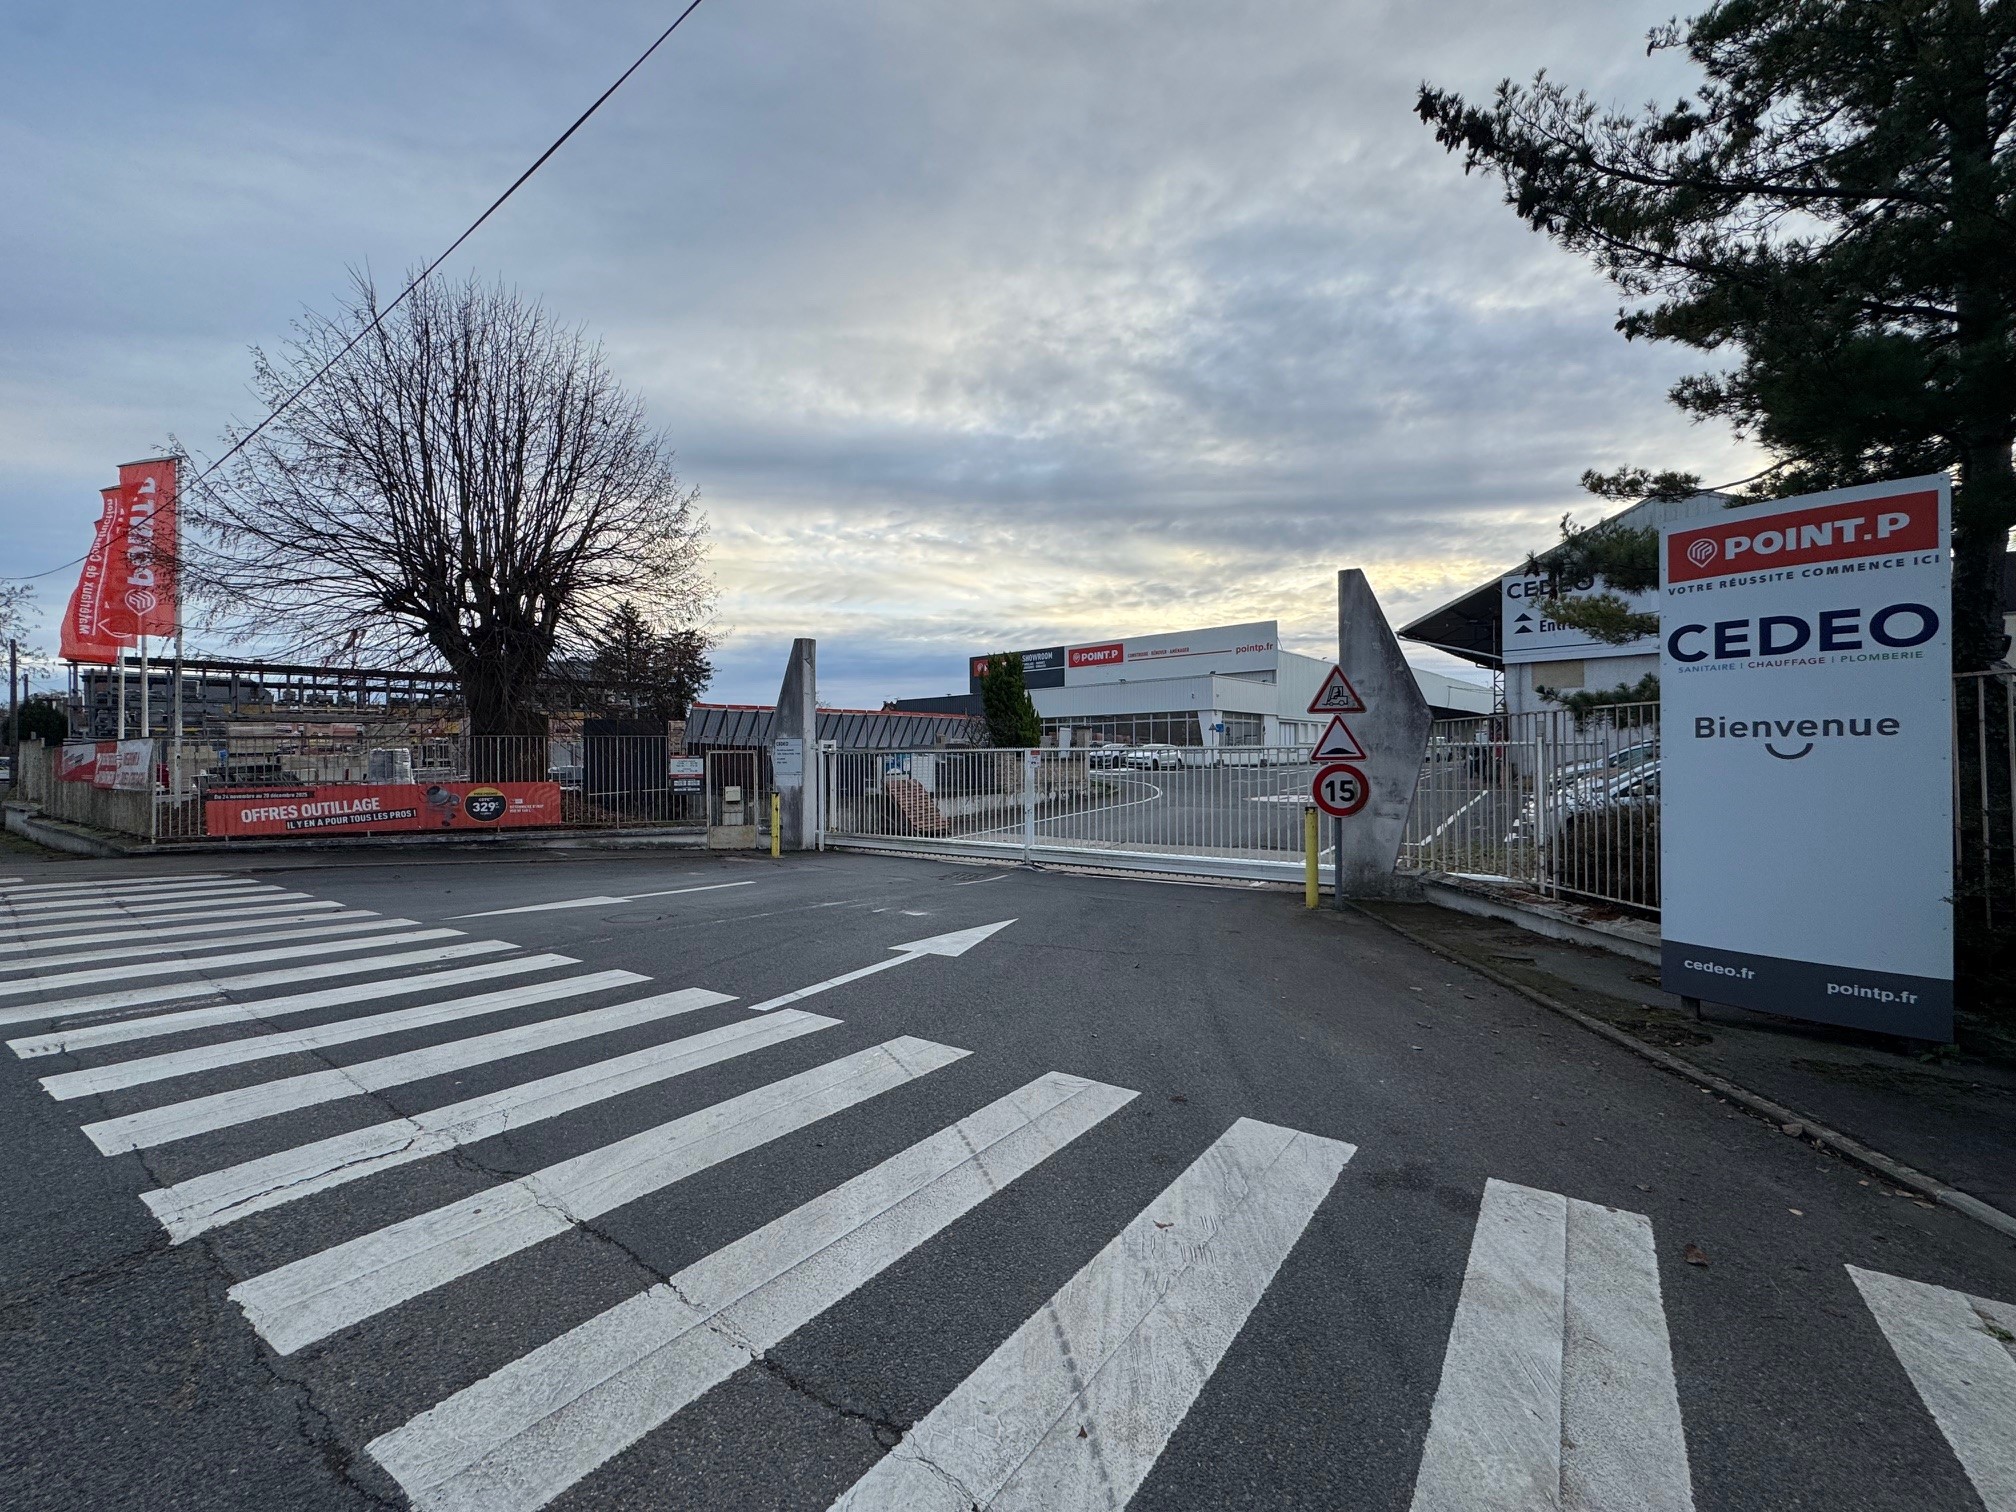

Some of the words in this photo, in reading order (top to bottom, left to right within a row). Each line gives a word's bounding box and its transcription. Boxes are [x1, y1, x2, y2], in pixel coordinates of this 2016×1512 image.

[1725, 512, 1910, 560] POINT.P
[1668, 582, 1713, 595] VOTRE
[1719, 571, 1794, 589] RÉUSSITE
[1801, 558, 1904, 578] COMMENCE
[1914, 554, 1940, 565] ICI
[1507, 576, 1594, 598] CEDO
[1667, 602, 1940, 662] CEDEO
[1022, 651, 1053, 662] SHOWROOM
[1081, 650, 1119, 661] POINT.P
[1235, 642, 1273, 655] pointp.fr
[1678, 662, 1736, 673] SANITAIRE
[1747, 656, 1826, 669] CHAUFFAGE
[1840, 650, 1924, 663] PLOMBERIE
[1694, 717, 1900, 739] Bienvenue
[1325, 780, 1355, 802] 15
[241, 805, 298, 823] OFFRES
[301, 797, 380, 817] OUTILLAGE
[287, 821, 294, 830] IL
[304, 820, 315, 828] EN
[317, 818, 324, 826] A
[325, 816, 348, 825] POUR
[349, 814, 372, 822] TOUS
[373, 812, 388, 820] LES
[390, 810, 411, 819] PROS
[1684, 958, 1755, 980] cedeo.fr
[1827, 982, 1918, 1005] pointp.fr
